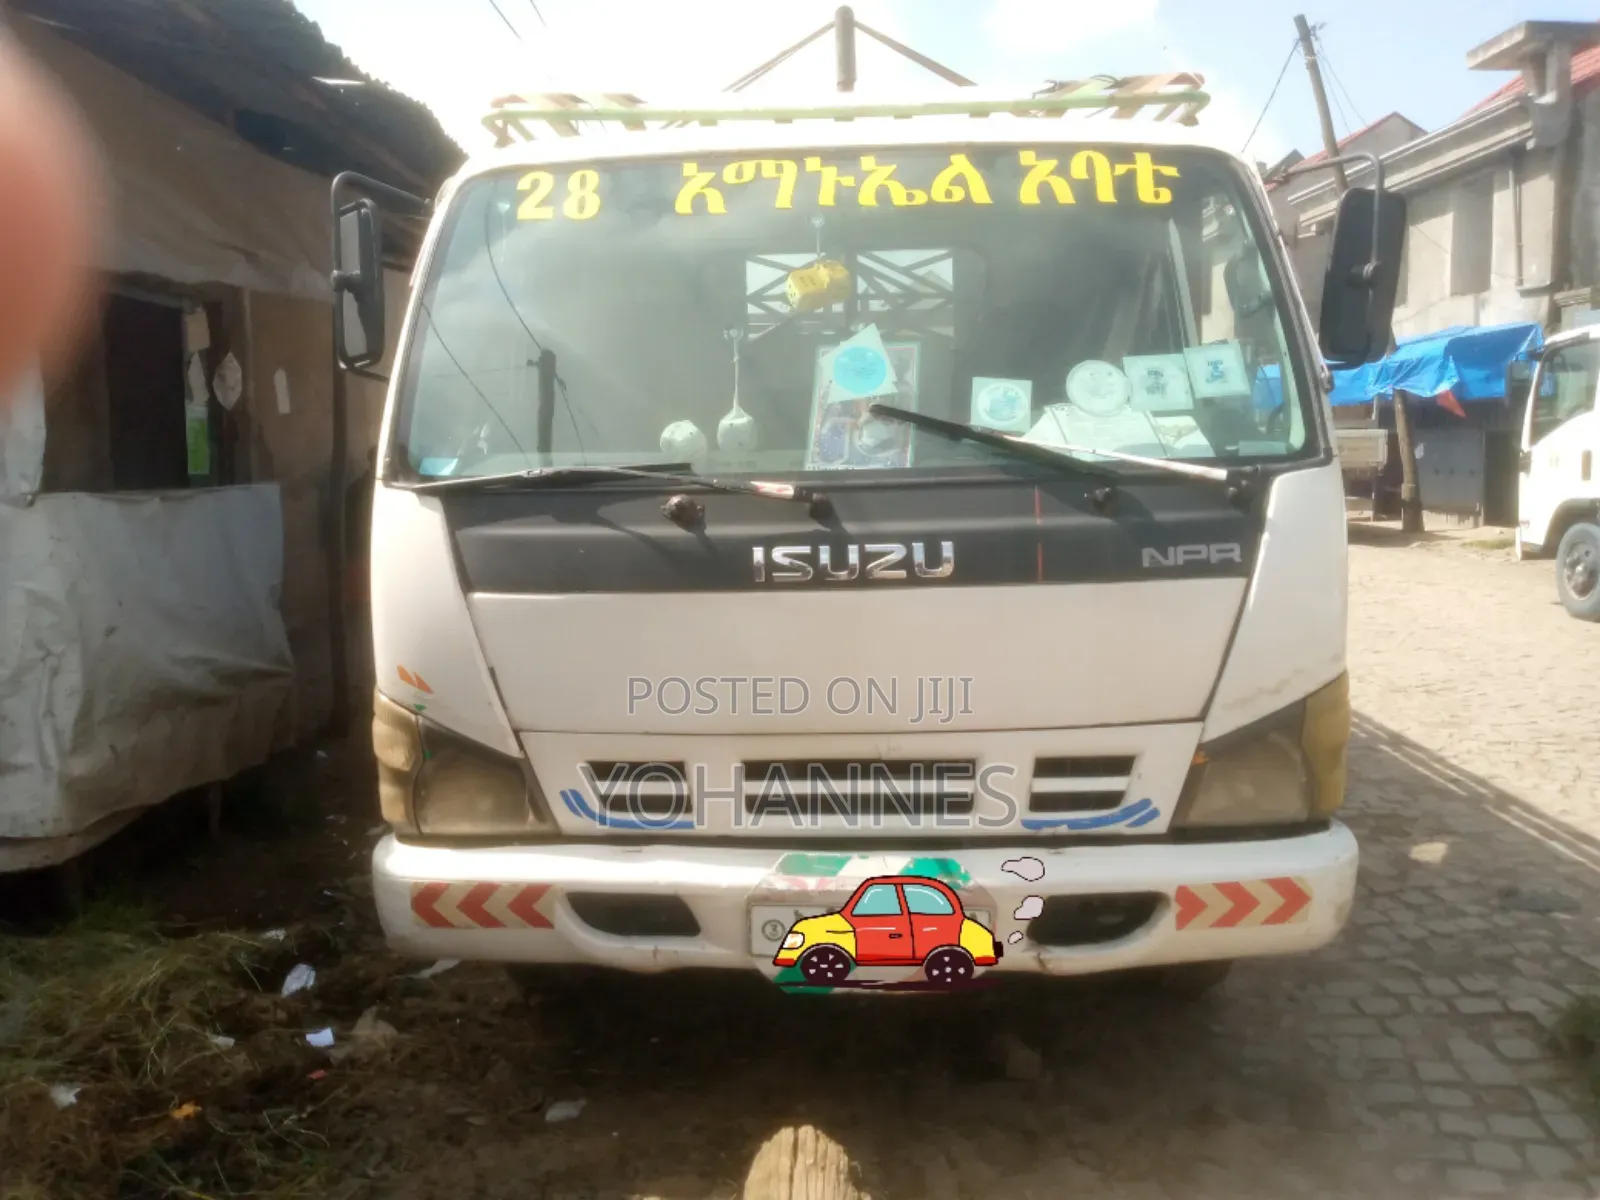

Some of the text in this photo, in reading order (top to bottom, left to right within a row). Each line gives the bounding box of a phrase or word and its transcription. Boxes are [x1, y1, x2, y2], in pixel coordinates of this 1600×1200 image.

[516, 169, 601, 220] 28
[674, 150, 1181, 215] አማኑኤል አባቴ
[751, 541, 955, 583] ISUZU
[1141, 542, 1243, 568] NPR
